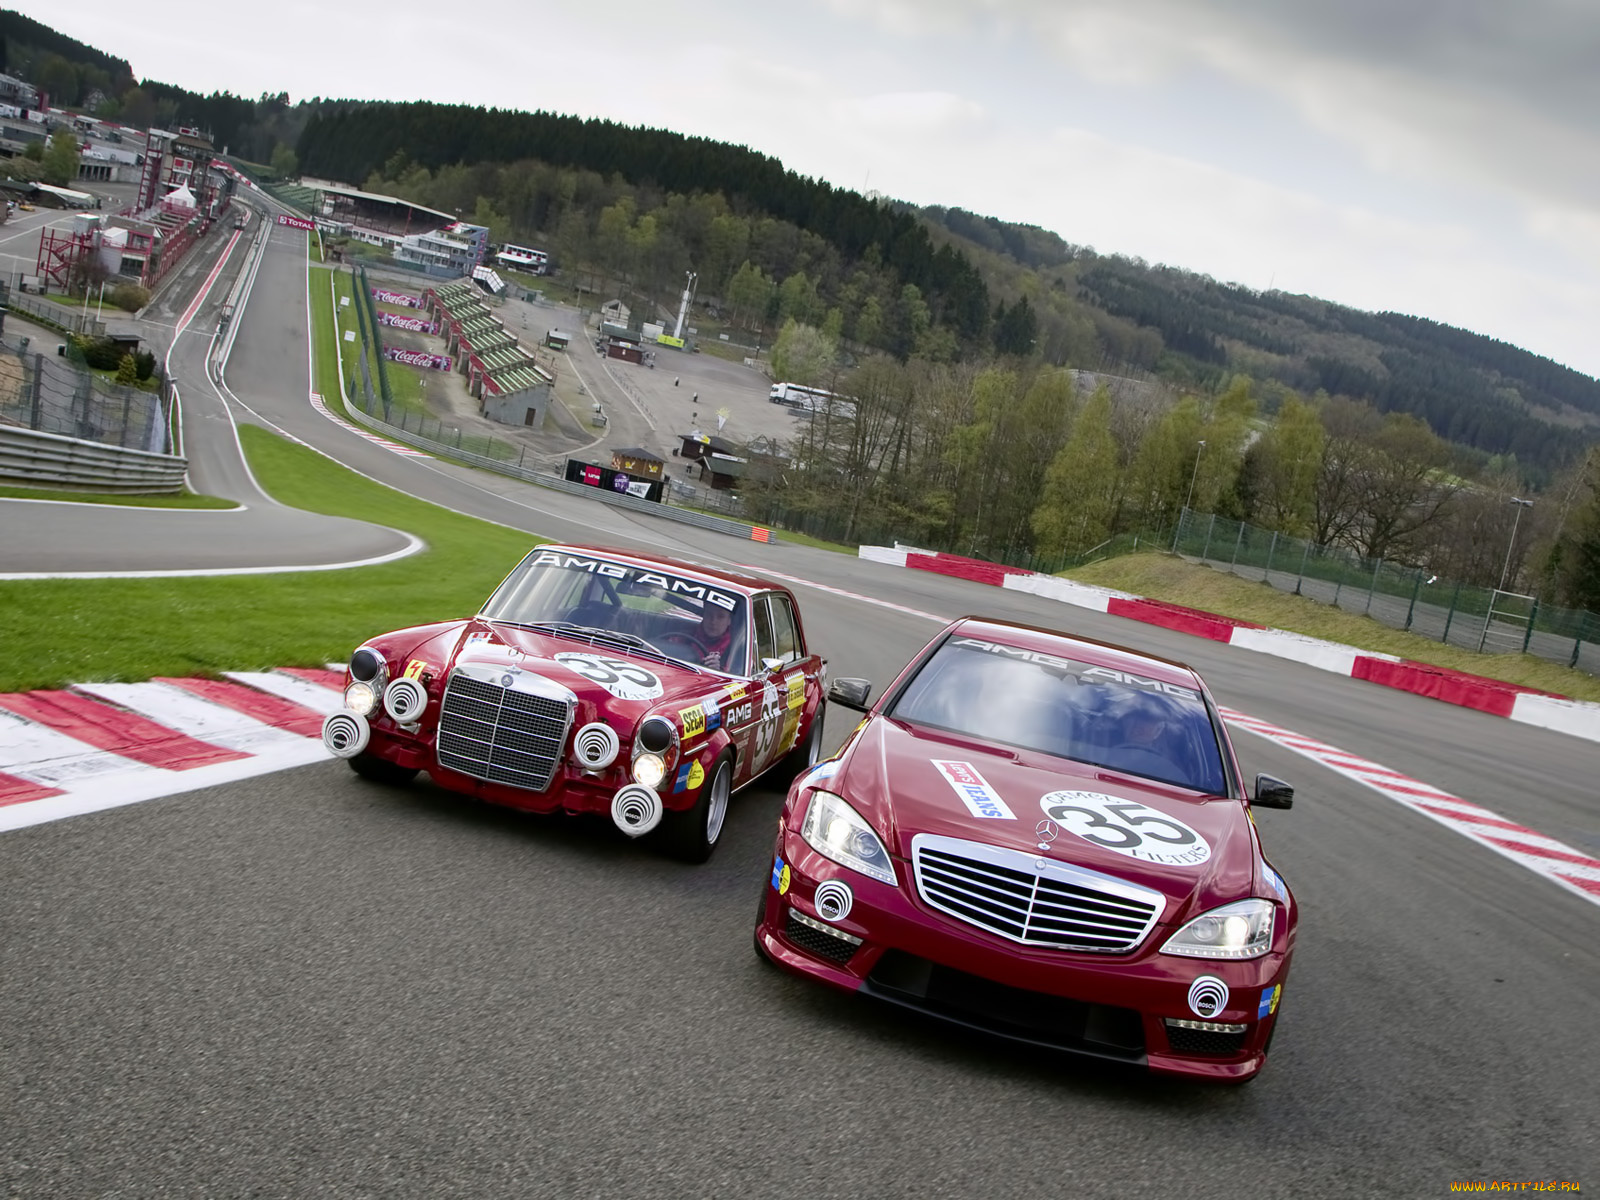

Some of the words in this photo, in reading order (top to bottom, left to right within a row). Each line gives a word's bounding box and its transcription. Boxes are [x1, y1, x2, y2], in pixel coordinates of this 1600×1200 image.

[287, 218, 313, 230] TOTAL
[531, 555, 628, 579] AMG
[636, 573, 737, 612] AMG
[558, 657, 658, 688] 35
[952, 638, 1068, 669] AMG
[1083, 666, 1198, 701] AMG
[682, 711, 705, 733] SEGA
[726, 703, 752, 728] AMG
[962, 785, 1003, 817] JEANS
[1048, 804, 1197, 848] 35
[1131, 844, 1208, 865] FILTERS
[822, 903, 839, 914] BOSCH
[1197, 1001, 1216, 1010] BOSCH
